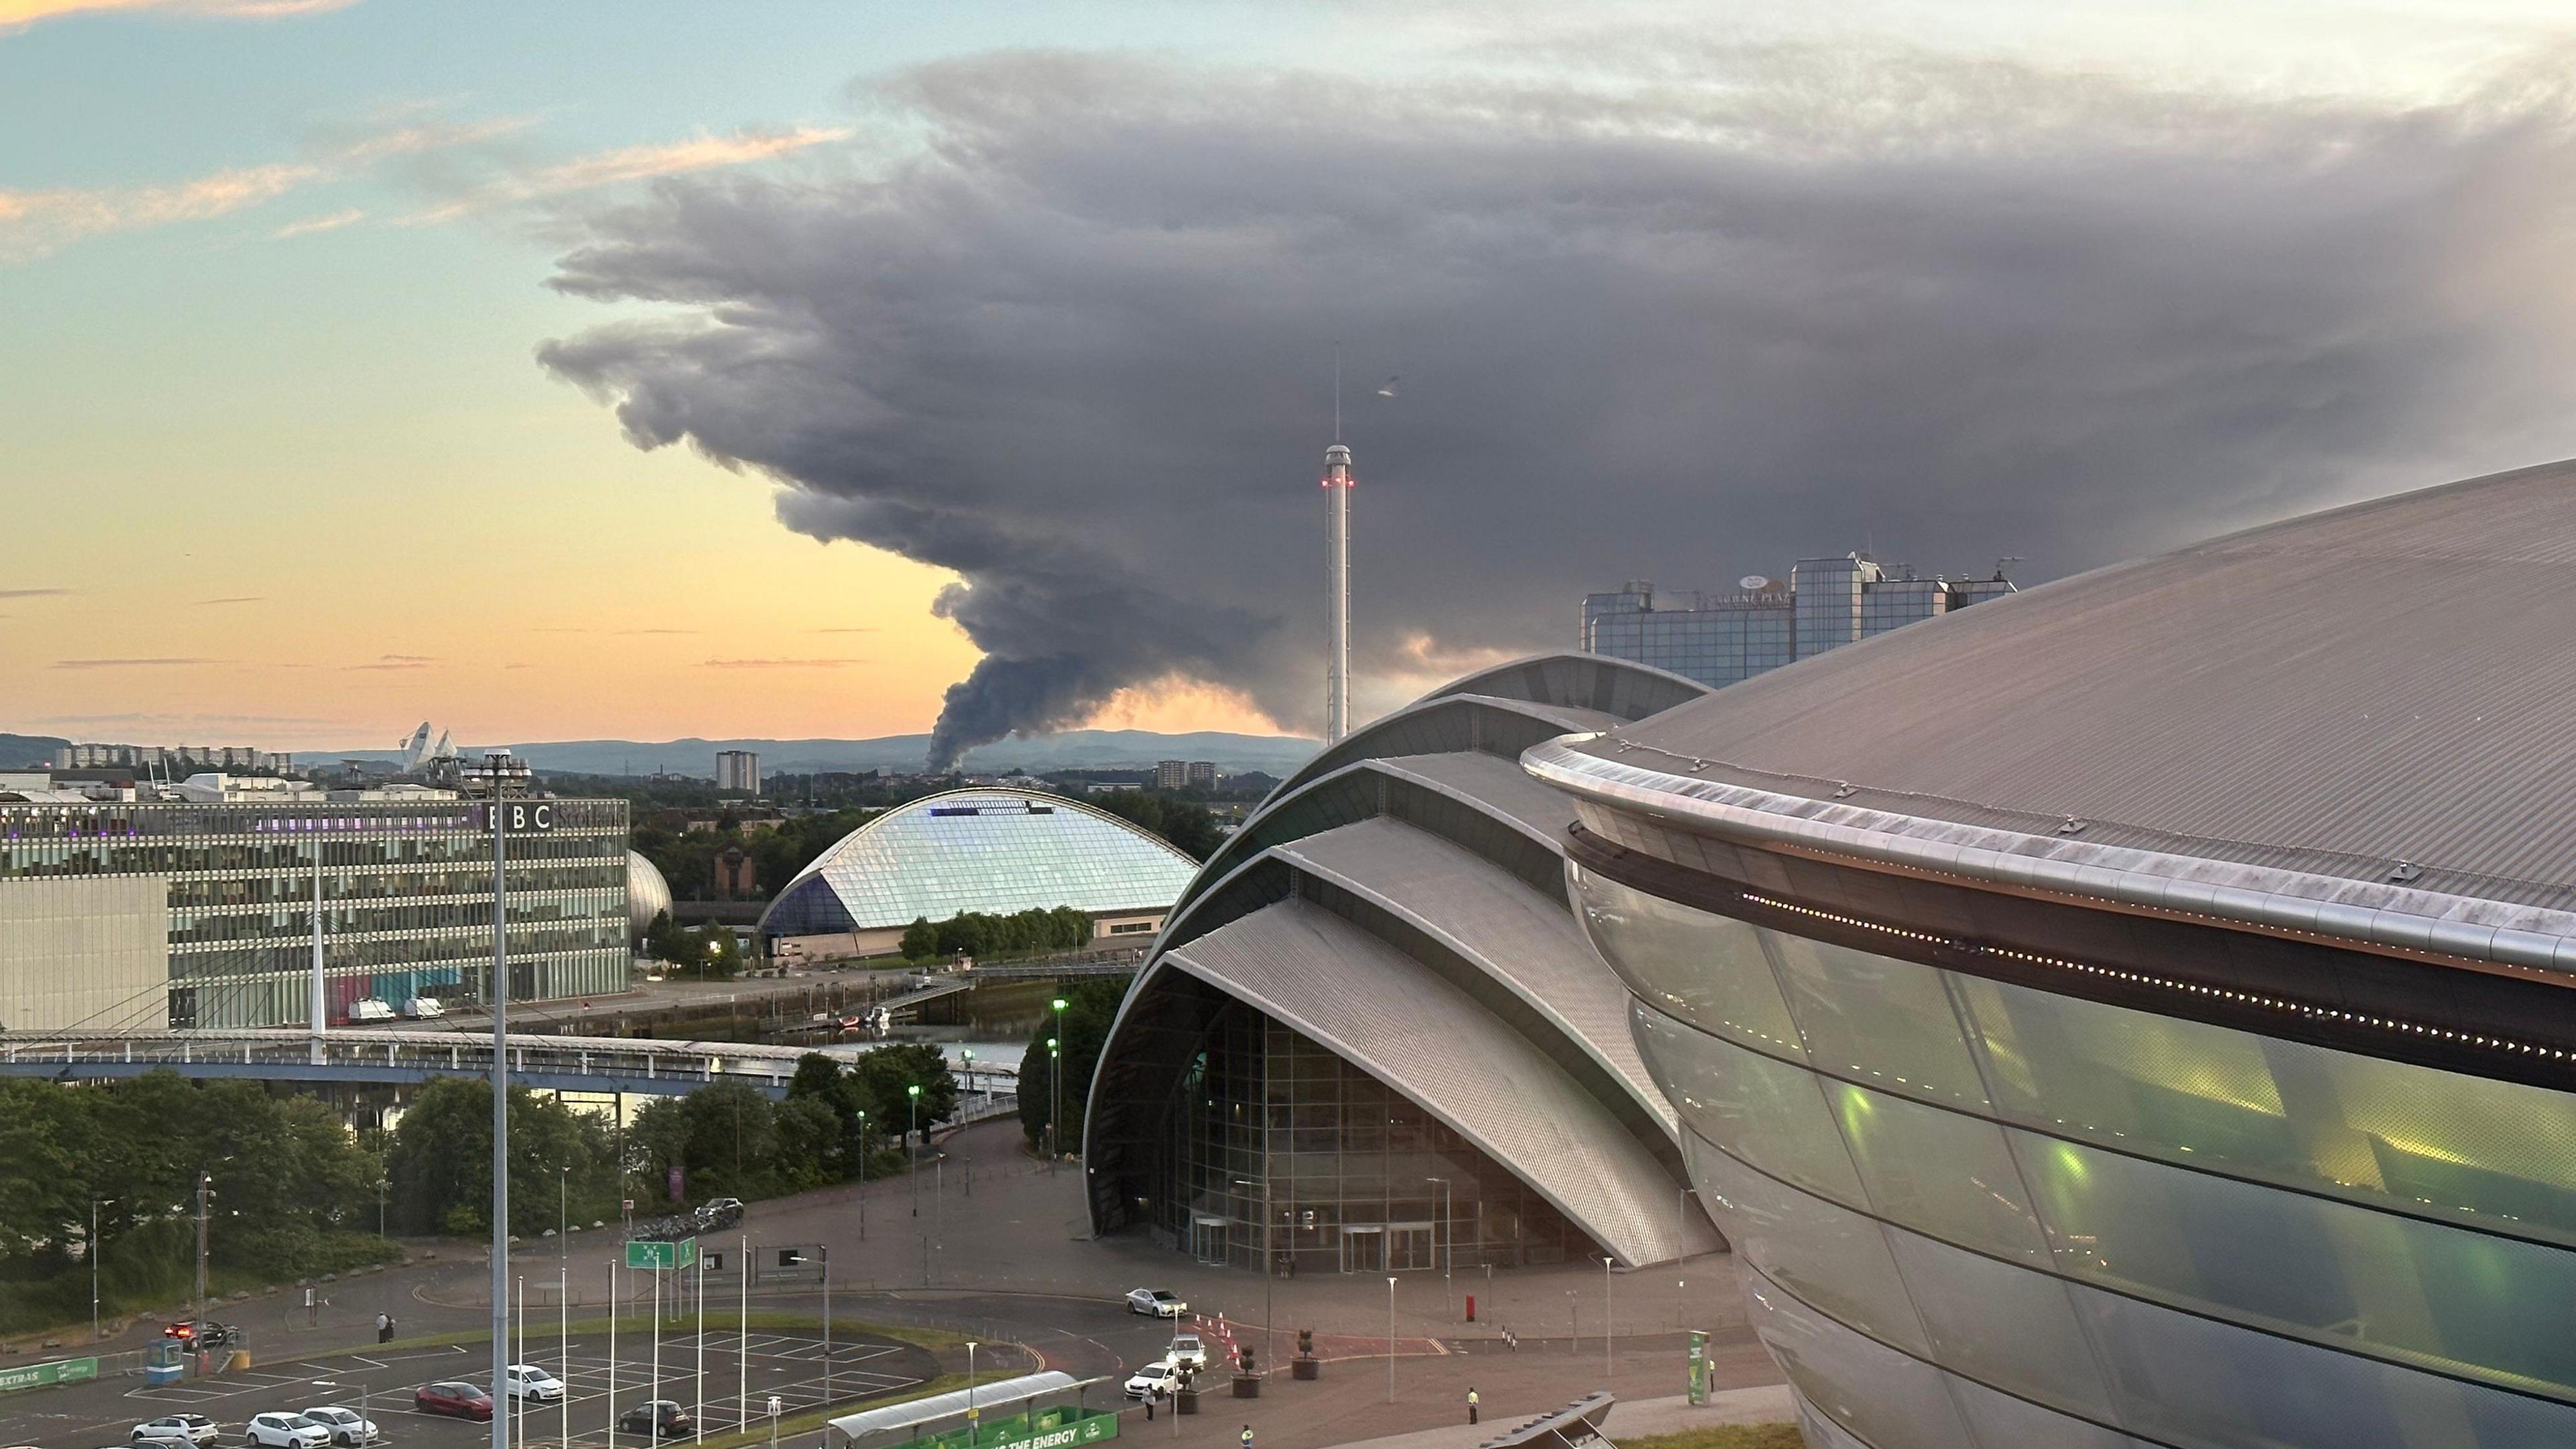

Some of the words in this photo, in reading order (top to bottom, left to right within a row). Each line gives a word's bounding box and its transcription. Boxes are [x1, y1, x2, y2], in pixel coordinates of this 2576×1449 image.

[1761, 592, 1790, 602] PLAZ
[558, 804, 625, 828] Scotland
[0, 1372, 39, 1386] EXTRAS
[1008, 1439, 1031, 1449] THE
[1032, 1428, 1077, 1449] ENERGY
